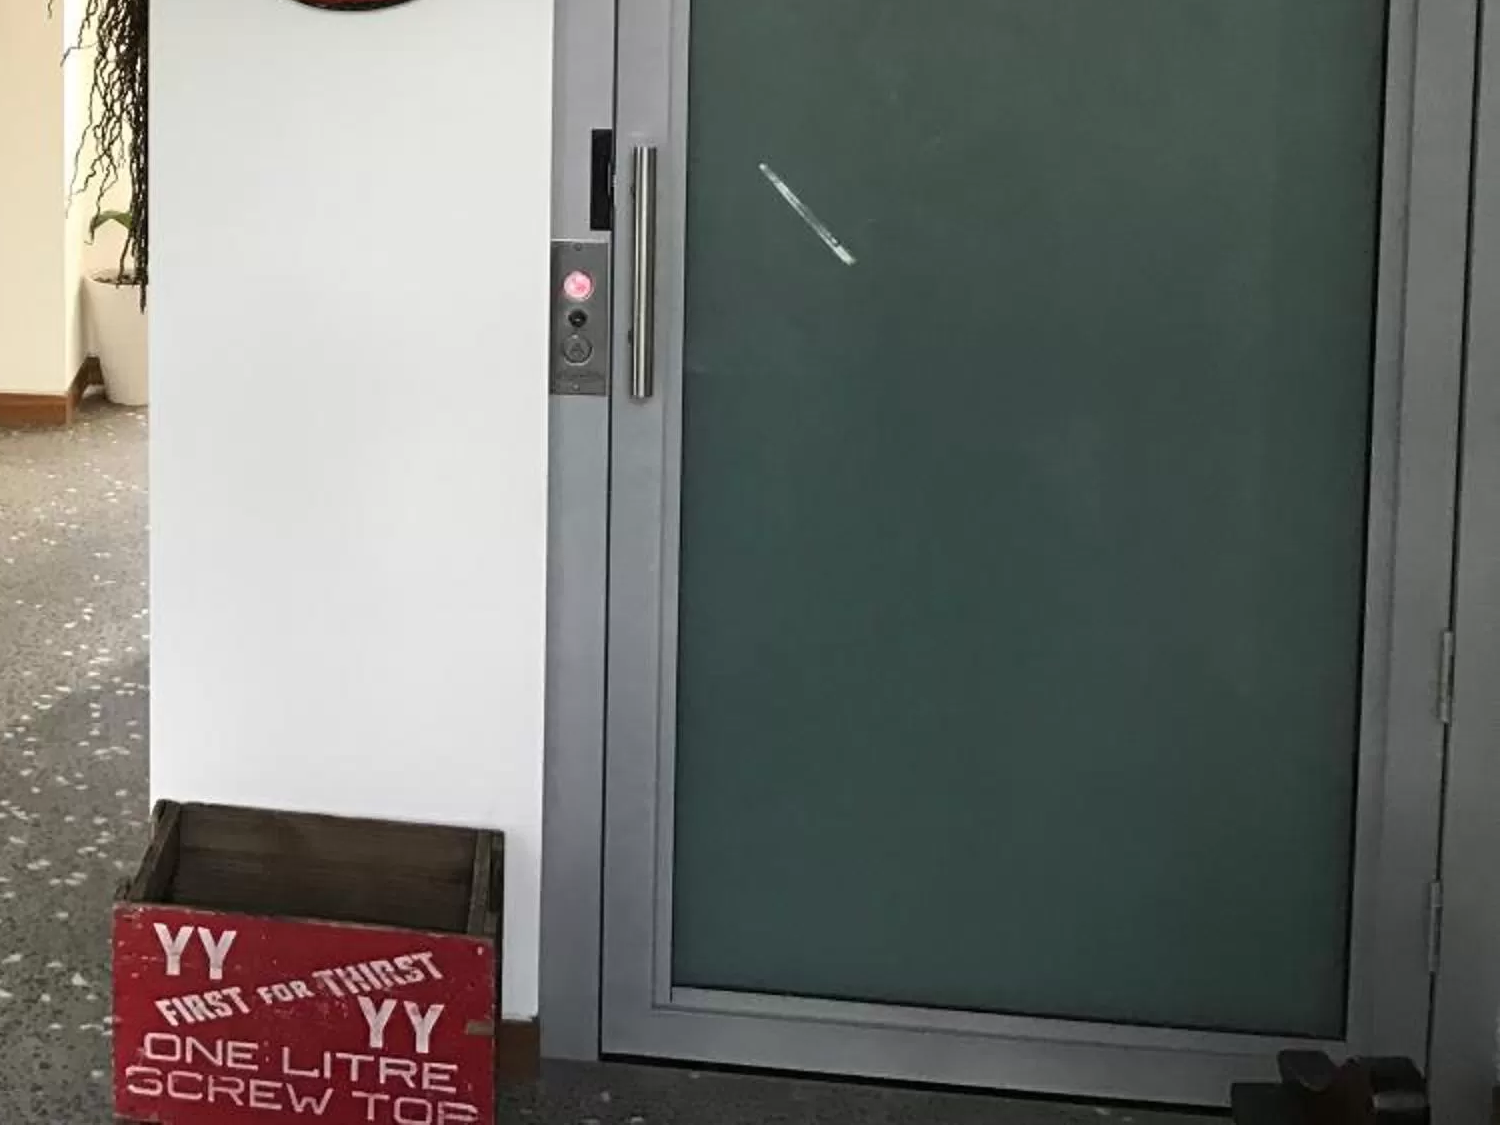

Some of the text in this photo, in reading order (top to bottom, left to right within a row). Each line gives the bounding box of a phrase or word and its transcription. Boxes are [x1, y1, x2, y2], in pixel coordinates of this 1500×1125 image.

[153, 922, 237, 981] YY
[155, 951, 443, 1028] FIRST FOR THIRST
[359, 996, 445, 1054] YY
[143, 1032, 458, 1093] ONE LITRE
[125, 1066, 479, 1125] SCREW TOP
